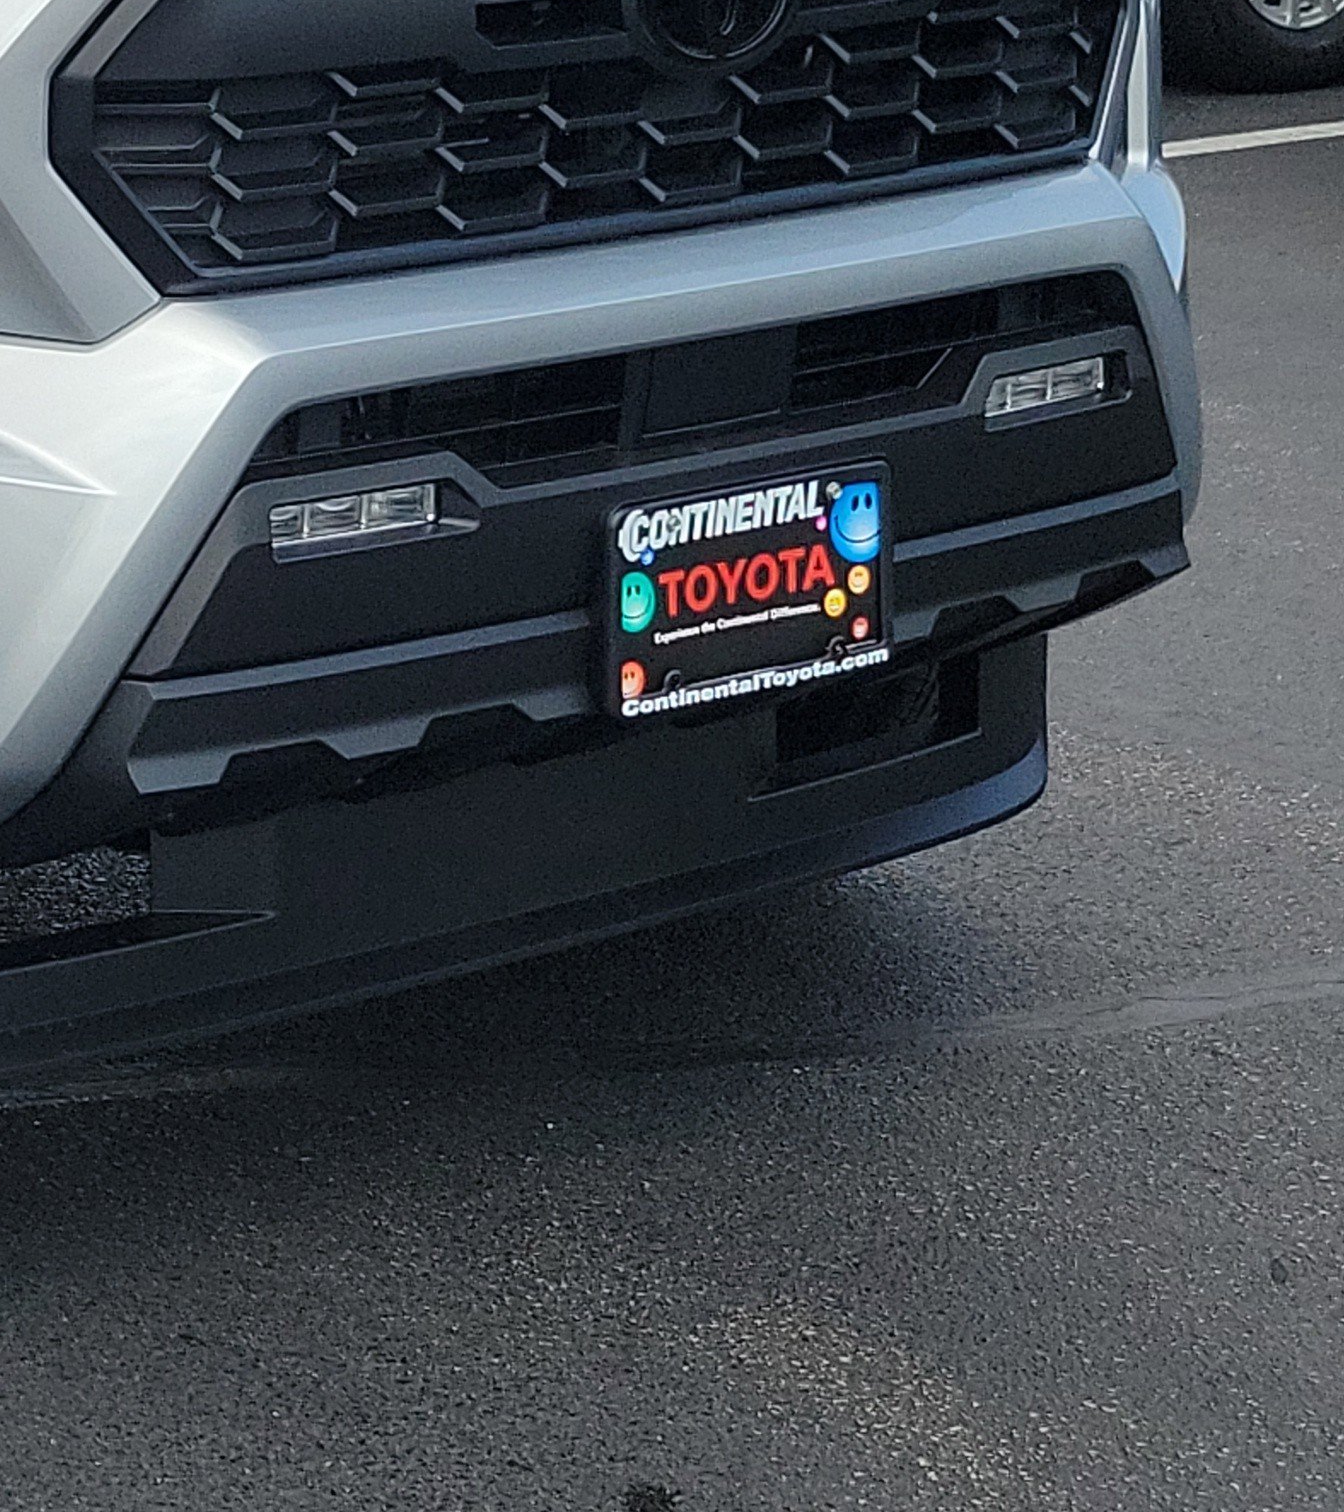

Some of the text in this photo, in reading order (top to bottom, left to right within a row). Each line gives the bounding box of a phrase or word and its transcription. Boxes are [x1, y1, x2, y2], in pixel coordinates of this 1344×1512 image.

[618, 480, 824, 562] CONTINENTAL
[657, 544, 836, 618] TOYOTA
[621, 647, 889, 717] ContinentalToyota.com
